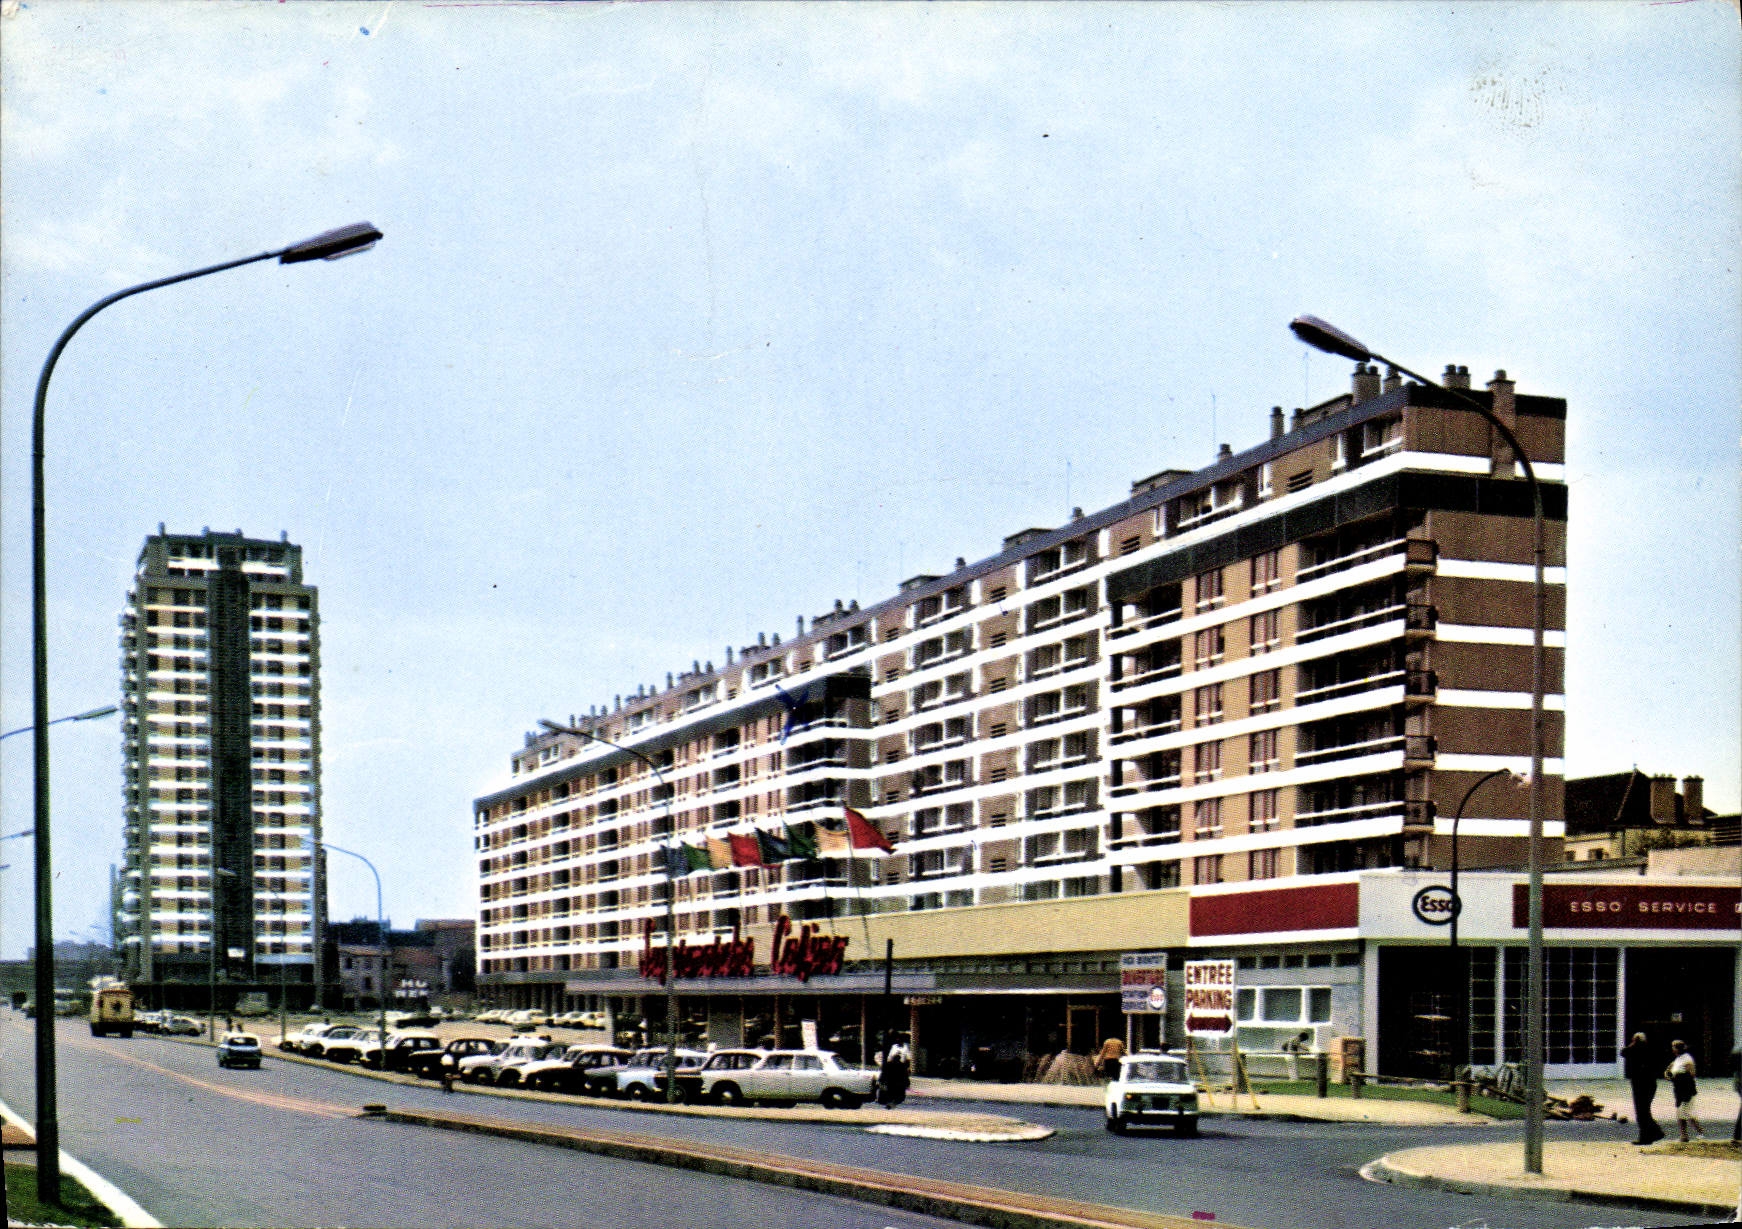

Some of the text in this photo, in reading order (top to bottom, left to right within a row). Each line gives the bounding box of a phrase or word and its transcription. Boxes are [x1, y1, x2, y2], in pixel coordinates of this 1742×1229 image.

[1570, 901, 1717, 913] ESSO SERVICE
[1186, 989, 1232, 1010] PARKING
